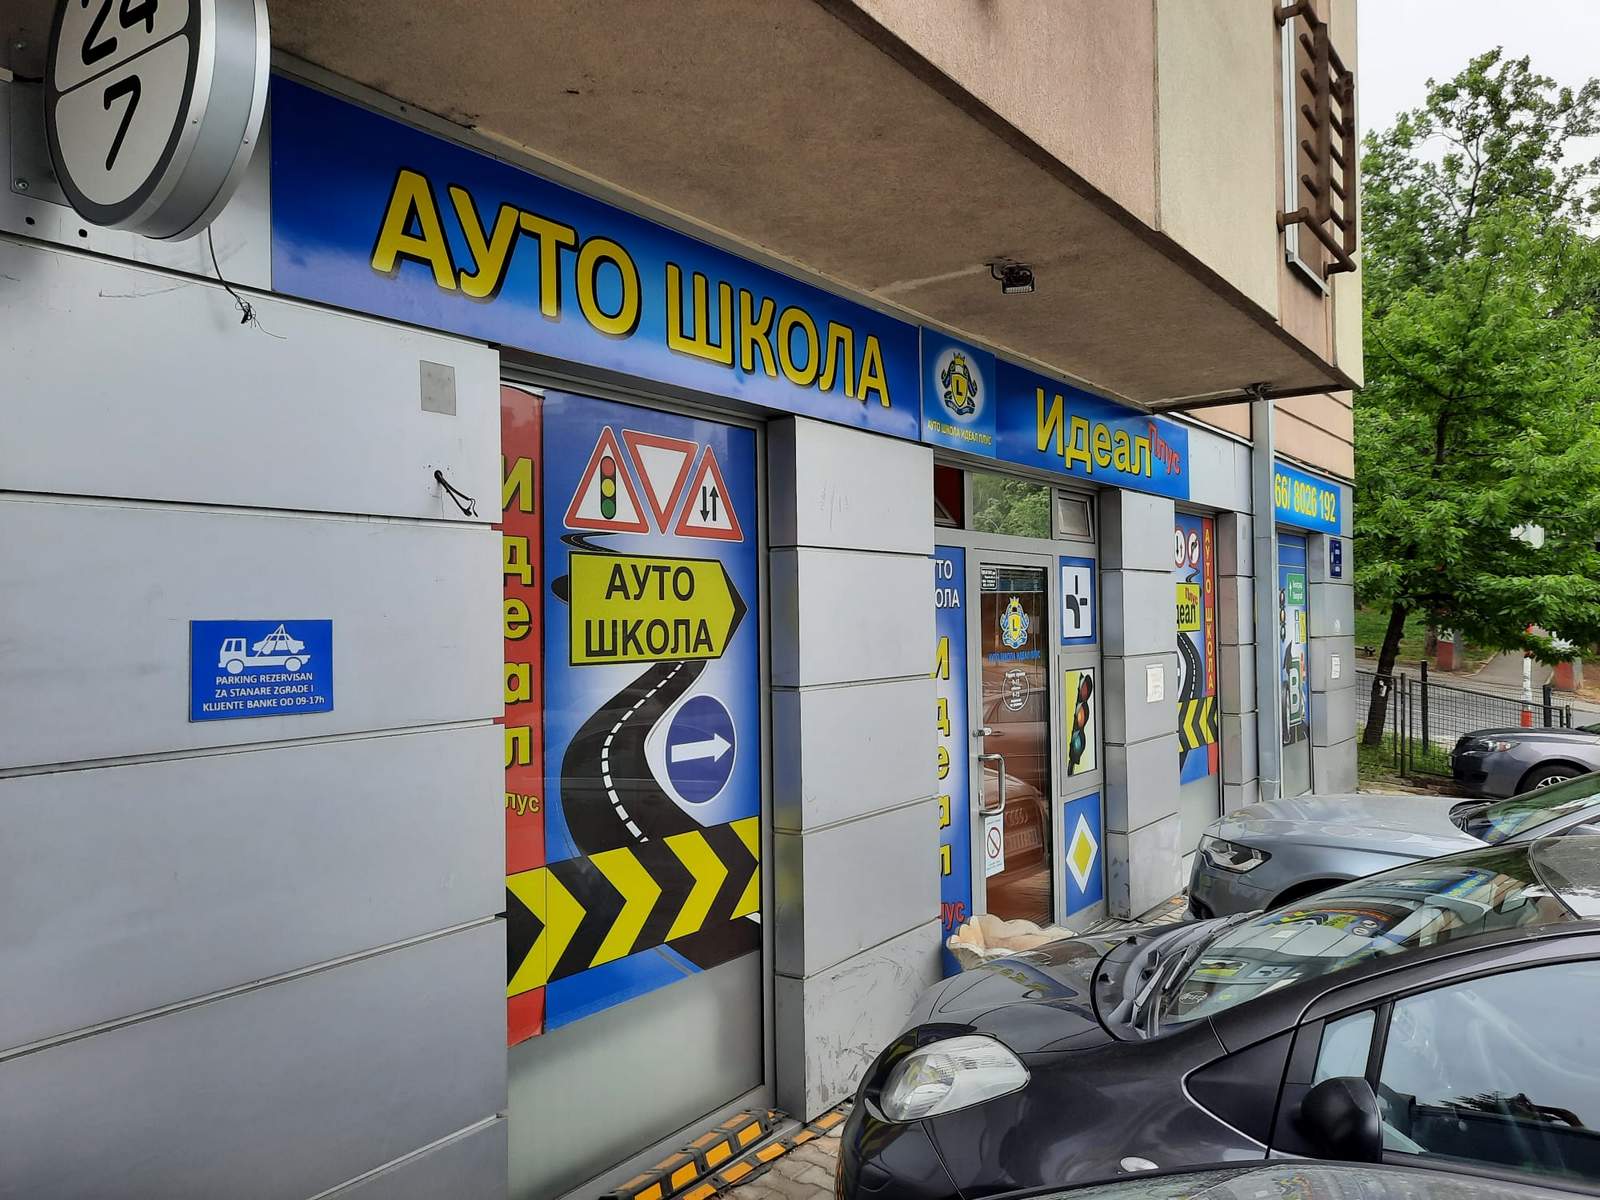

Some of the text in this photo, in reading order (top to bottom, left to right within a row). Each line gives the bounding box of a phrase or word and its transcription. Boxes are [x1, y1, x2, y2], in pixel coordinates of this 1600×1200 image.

[104, 74, 141, 171] 7
[371, 169, 891, 408] АУТО ШКОЛА
[1036, 387, 1151, 478] Идеал
[1148, 421, 1181, 475] Плус
[1294, 479, 1317, 518] 8026
[1319, 489, 1336, 523] 192
[605, 563, 695, 602] АУТО
[584, 618, 714, 658] ШКОЛА
[1205, 607, 1214, 689] ШКОЛА
[215, 689, 228, 698] ZA
[230, 686, 272, 698] STANARE
[273, 685, 310, 695] ZGRADE
[216, 672, 313, 686] PARKING REZERVISAN
[203, 696, 325, 712] KLIJENTE BANKE OD 09-17h
